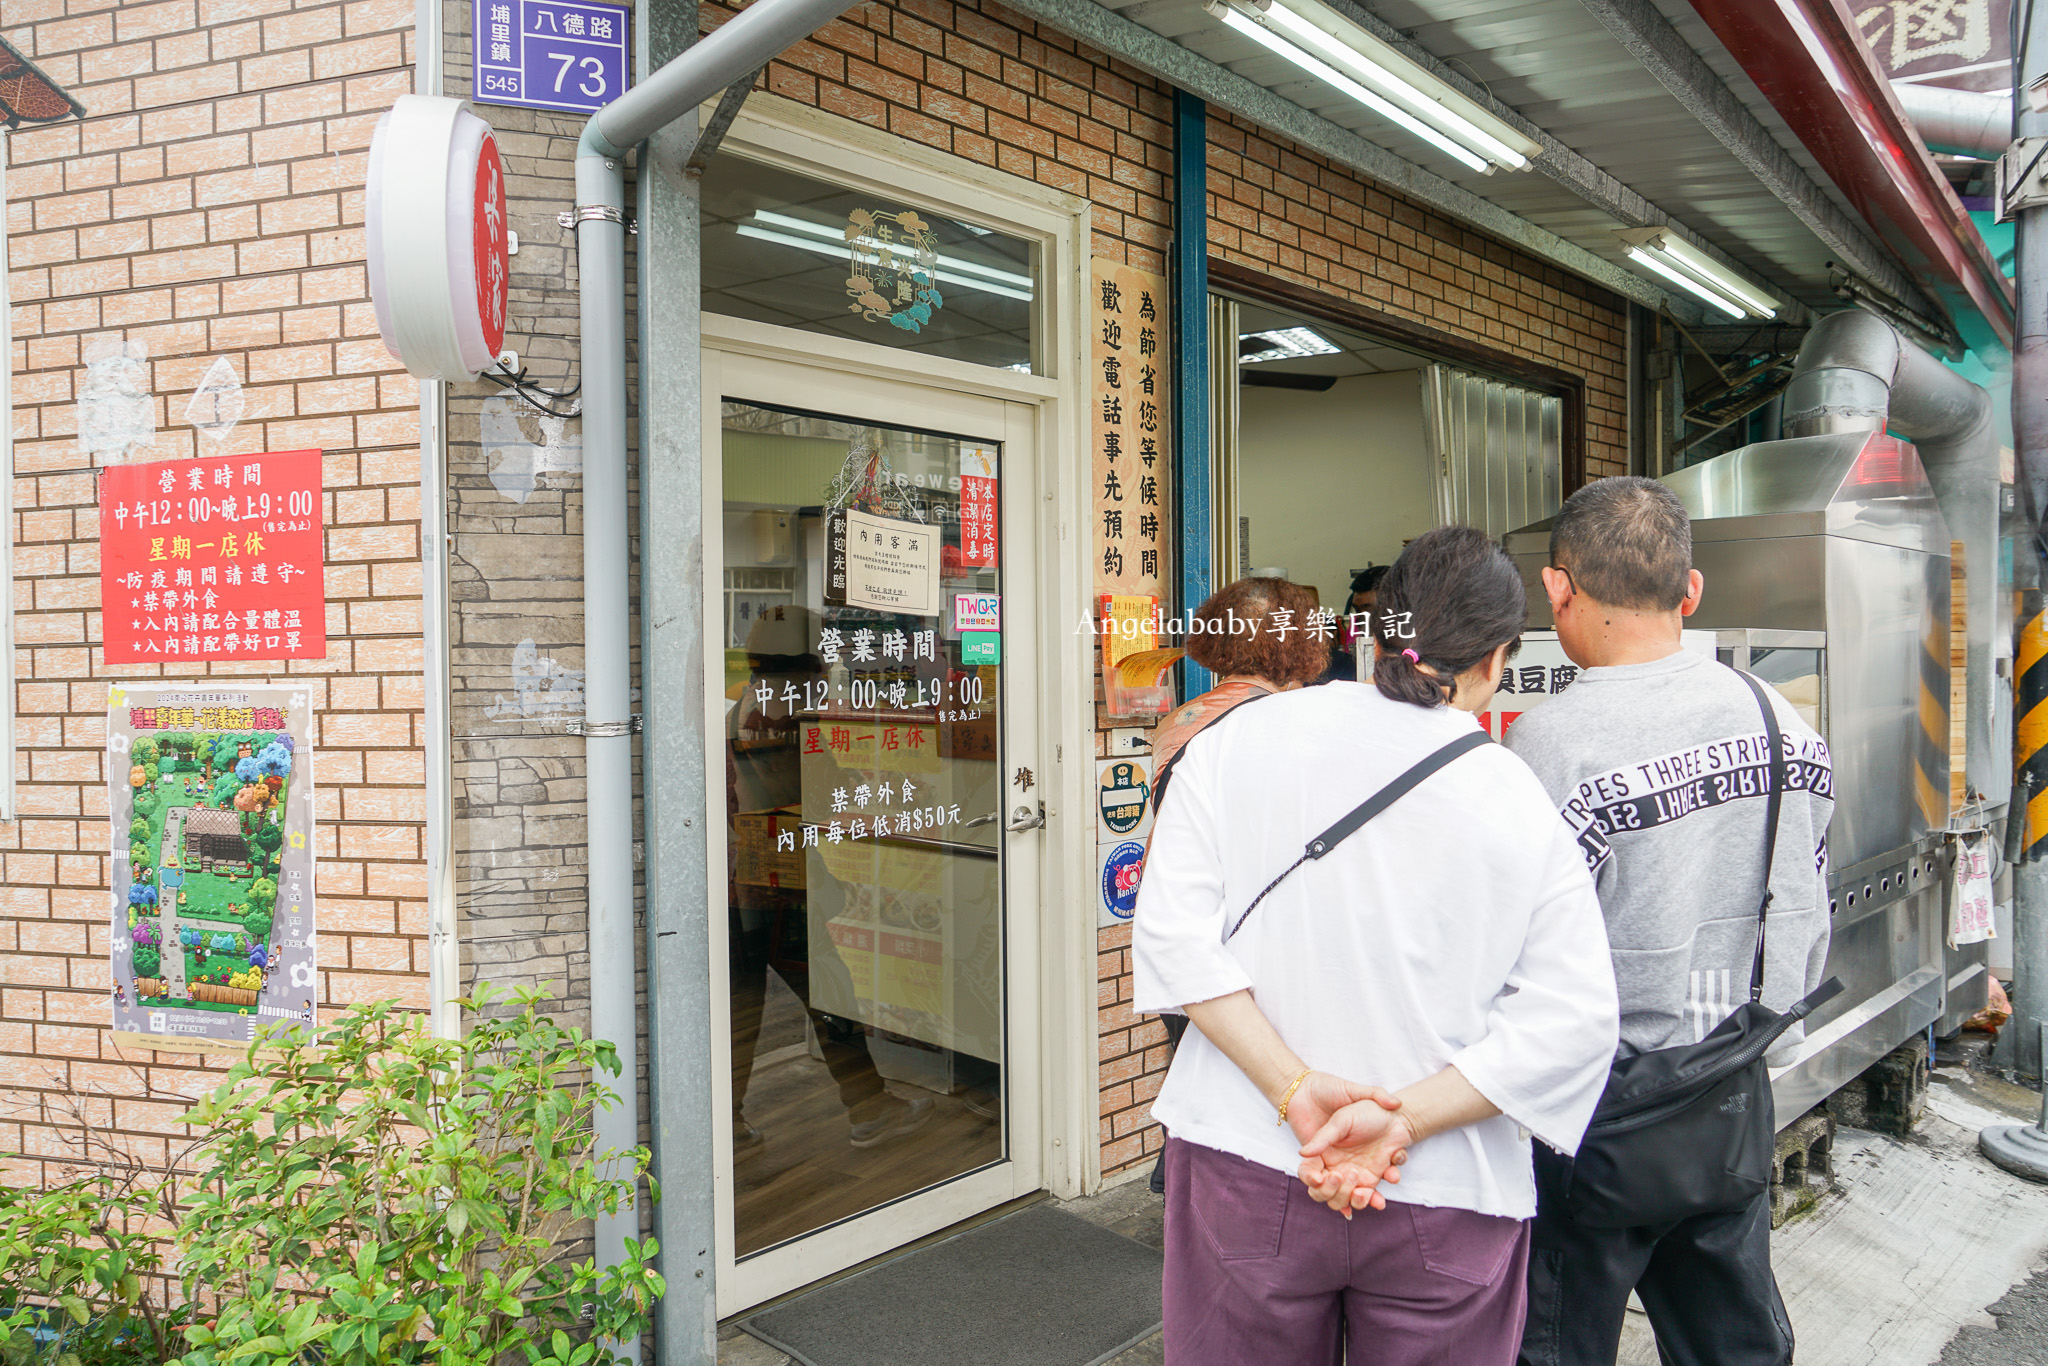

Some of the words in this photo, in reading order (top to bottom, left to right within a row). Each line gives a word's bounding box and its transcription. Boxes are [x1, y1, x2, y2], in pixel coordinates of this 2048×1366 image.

[490, 3, 511, 62] 埔里鎮
[534, 10, 613, 39] 八德路
[485, 75, 518, 92] 545
[548, 52, 606, 97] 73
[1101, 280, 1123, 577] 歡迎電話事先預約
[1139, 291, 1159, 579] 為節省您等候時間
[158, 462, 261, 493] 營業時間
[263, 519, 311, 534] (售完為止)
[966, 482, 979, 560] 清潔消毒
[982, 483, 995, 561] 本店定時
[148, 531, 266, 562] 星期一店休
[833, 518, 846, 589] 歡迎光臨
[860, 530, 919, 552] 內用客滿
[143, 588, 220, 612] 禁帶外食
[143, 609, 302, 633] 入內請配合量體溫
[143, 631, 302, 655] 入內請配帶好口罩
[817, 627, 935, 663] 營業時間
[967, 644, 981, 652] LINE
[983, 644, 994, 653] Pay
[803, 724, 926, 755] 星期一店休
[1637, 748, 1703, 790] THREE
[1707, 732, 1796, 770] STRIPS
[830, 779, 917, 814] 禁帶外食
[777, 803, 963, 852] 內用每位低消$50元
[1126, 818, 1138, 831] PORK
